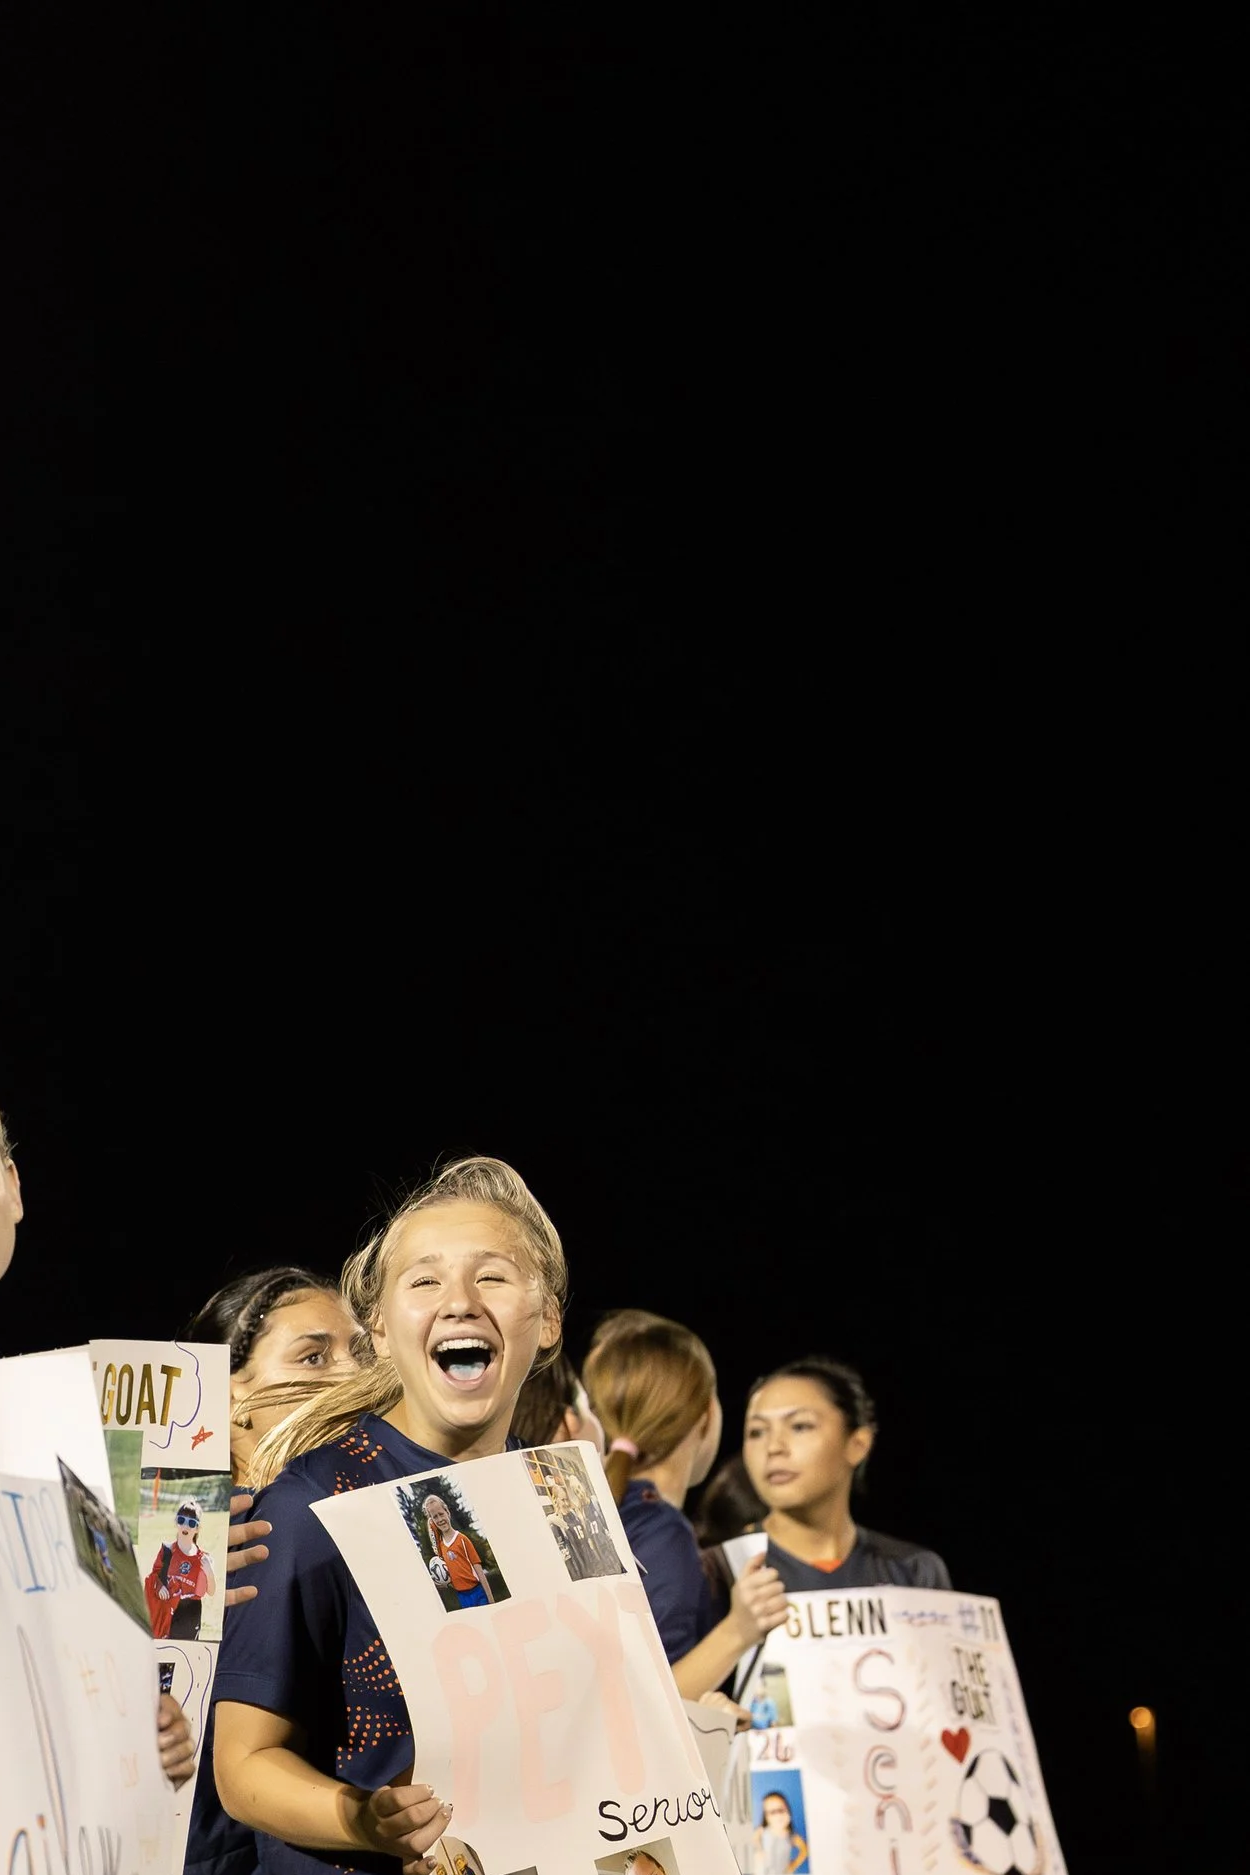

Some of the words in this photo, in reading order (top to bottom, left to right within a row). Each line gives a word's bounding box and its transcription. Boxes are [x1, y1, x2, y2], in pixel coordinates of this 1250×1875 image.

[100, 1362, 182, 1427] GOAT
[784, 1597, 889, 1639] GLENN
[754, 1730, 795, 1763] 26
[598, 1787, 721, 1842] Senior
